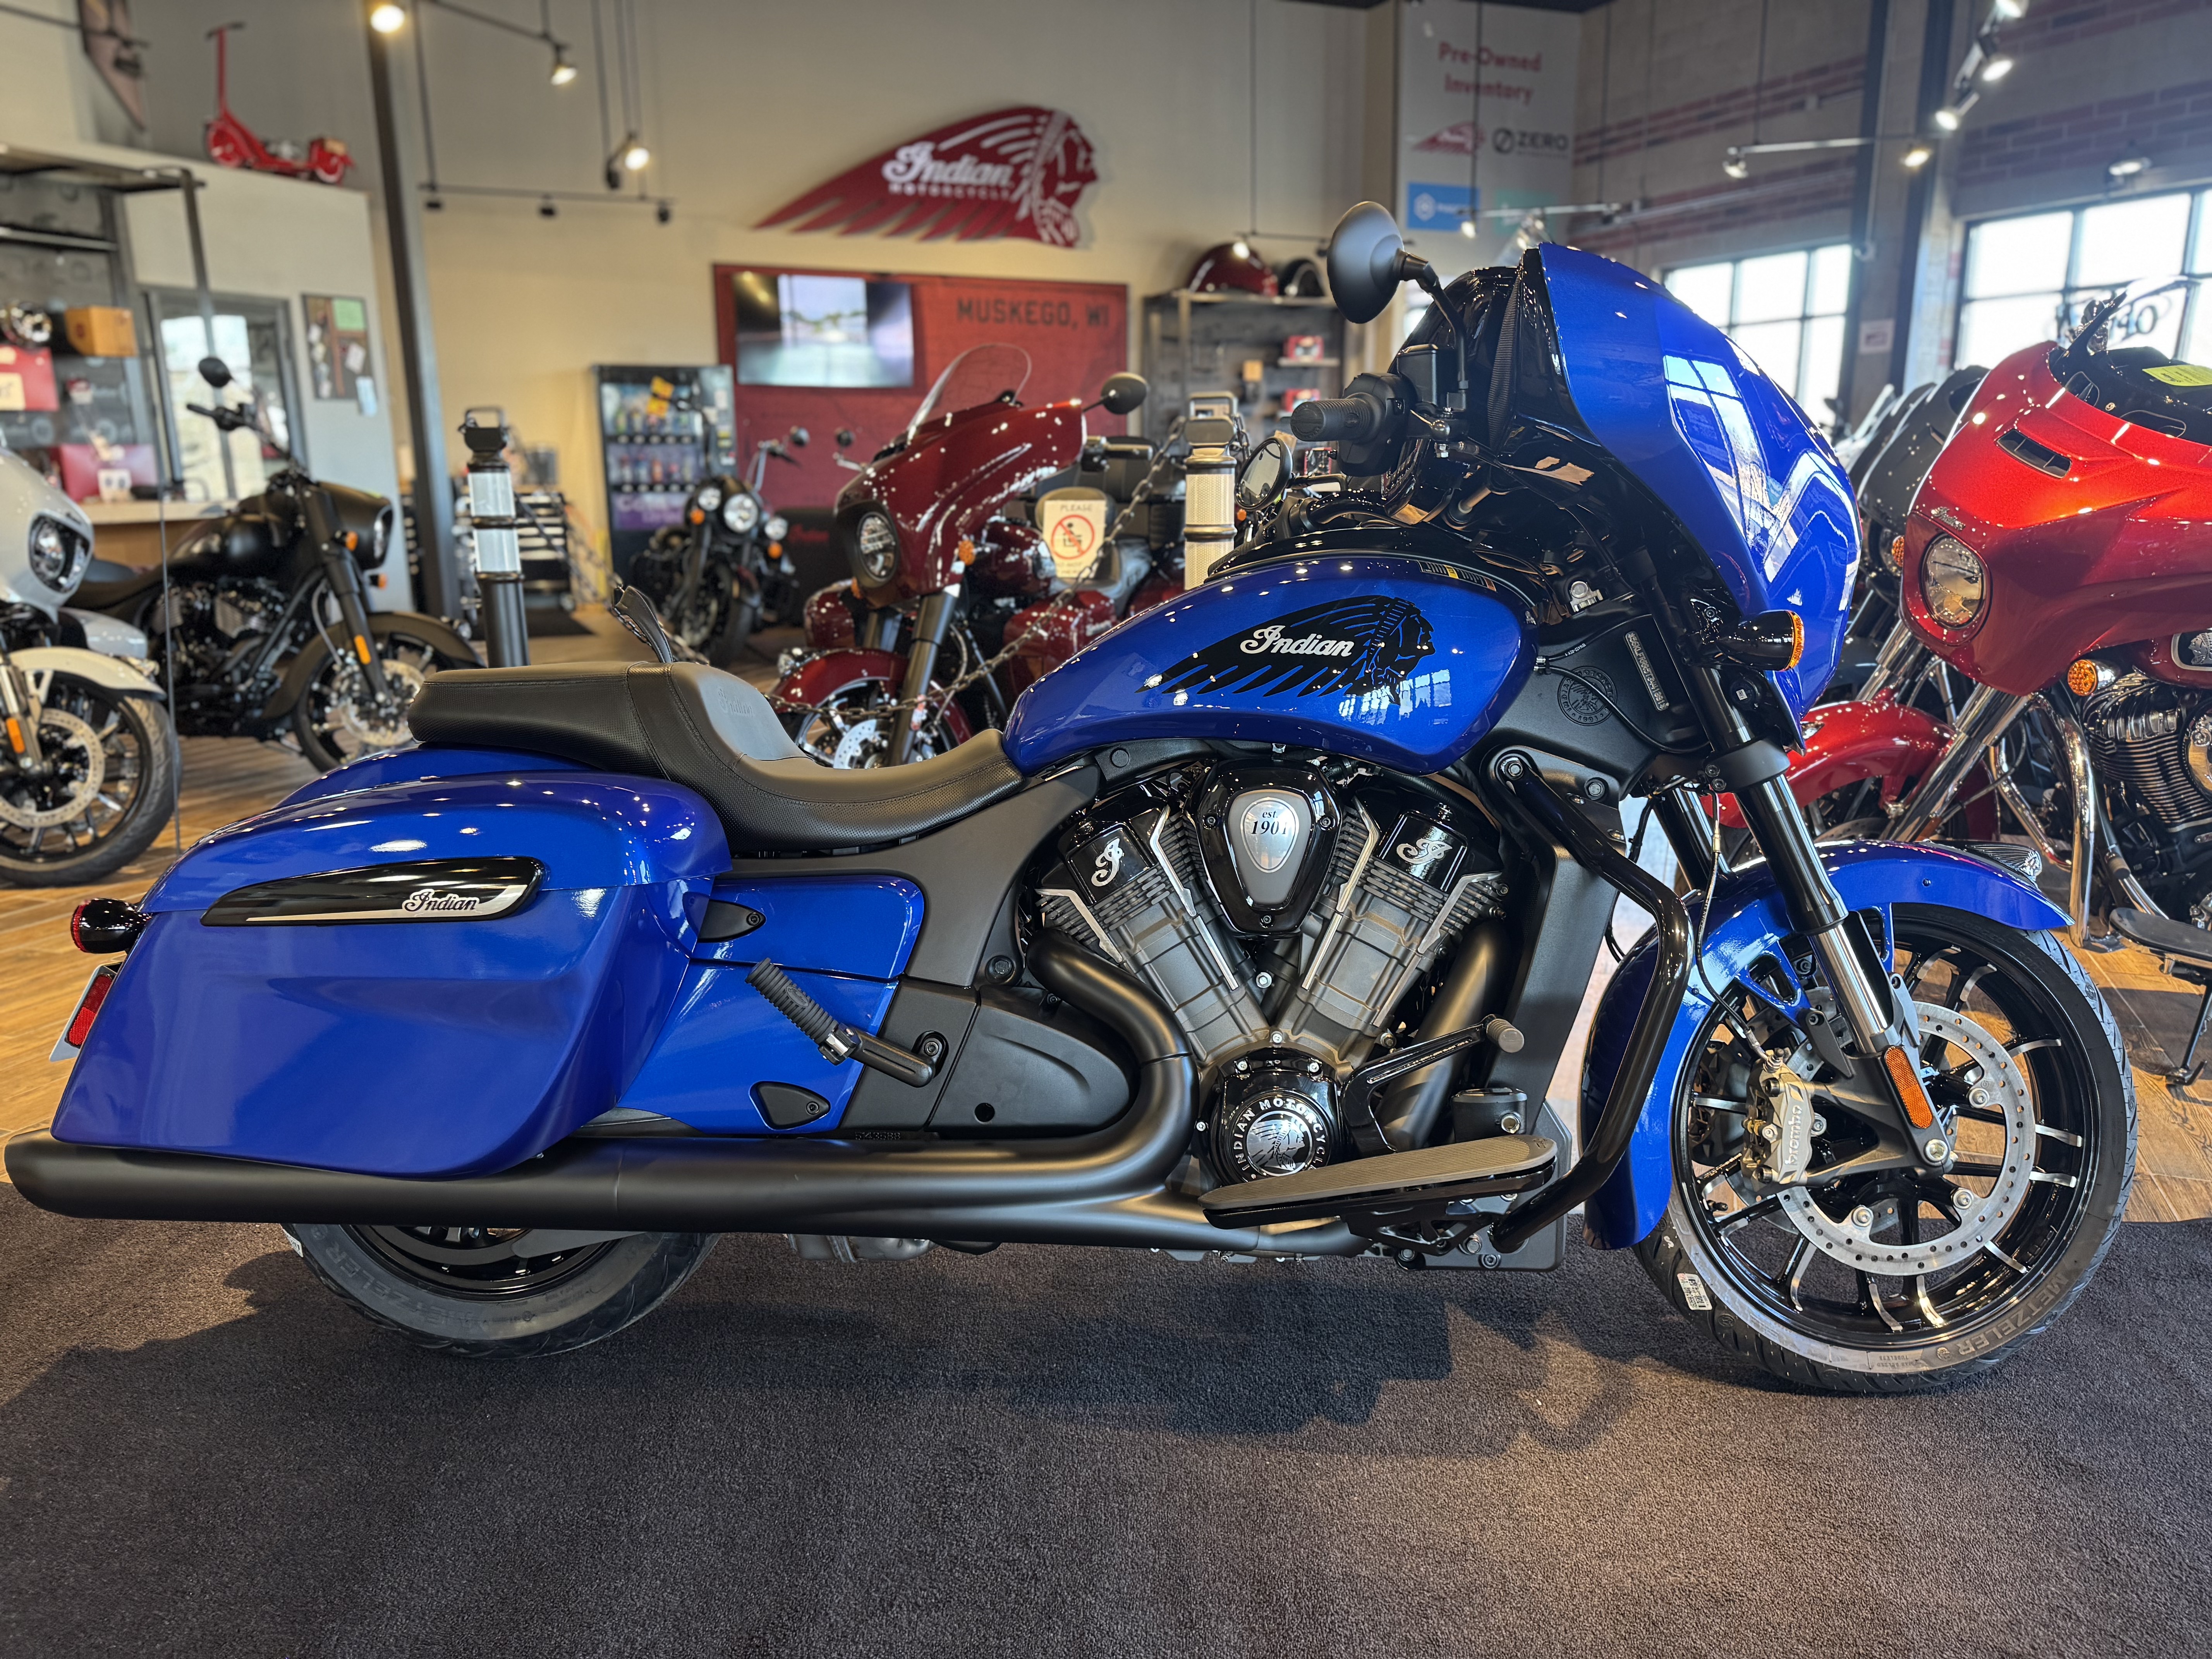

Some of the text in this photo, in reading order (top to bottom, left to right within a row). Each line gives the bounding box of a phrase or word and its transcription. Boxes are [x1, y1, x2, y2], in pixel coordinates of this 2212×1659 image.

[1439, 41, 1542, 72] Pre-Owned
[1444, 72, 1534, 105] Inventory
[1518, 131, 1569, 151] ZERO
[881, 141, 1014, 187] Indian
[957, 297, 1110, 330] MUSKEGO, WI
[1240, 625, 1355, 657] Indian
[1250, 818, 1288, 836] 1901
[1262, 809, 1278, 819] est.
[404, 891, 477, 911] Indian
[1233, 1108, 1256, 1171] INDIAN
[1784, 1105, 1803, 1165] brembo
[1957, 1273, 2069, 1355] METZELER
